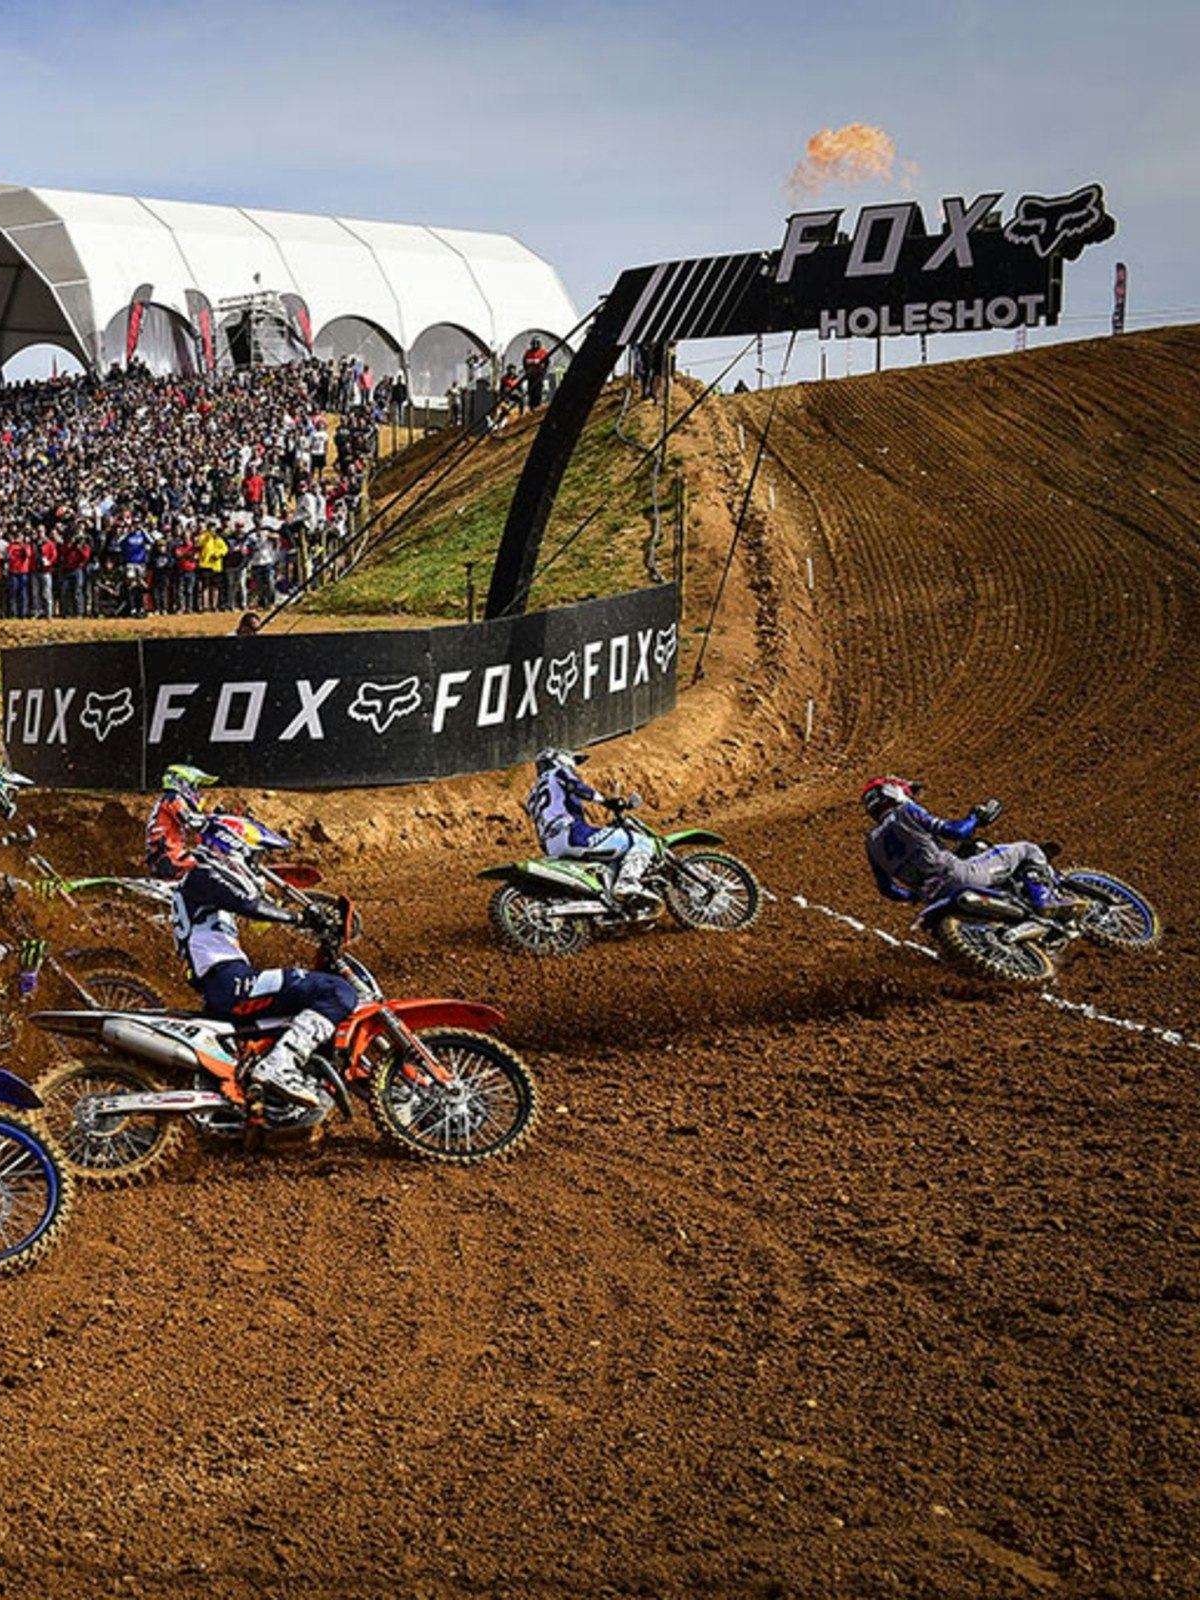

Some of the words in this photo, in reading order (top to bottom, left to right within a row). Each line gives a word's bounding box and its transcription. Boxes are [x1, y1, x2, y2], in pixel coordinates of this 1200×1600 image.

[775, 188, 1004, 284] FOX
[819, 294, 1046, 339] HOLESHOT
[431, 656, 543, 733] FOX
[588, 629, 653, 700] FOX
[5, 687, 77, 745] FOX
[147, 677, 341, 744] FOX
